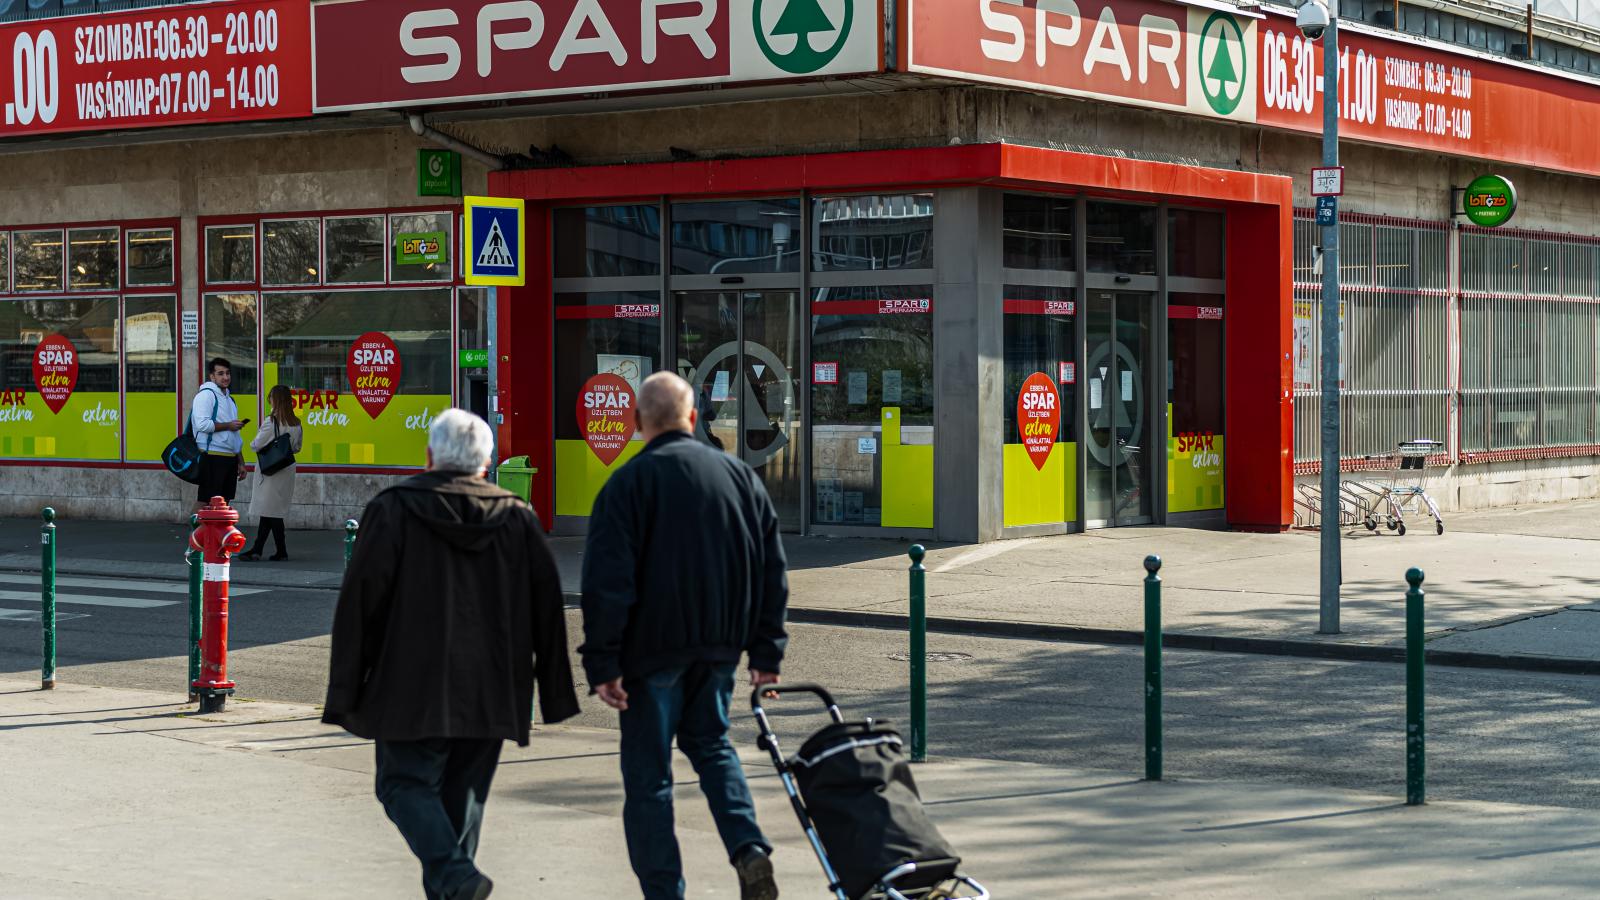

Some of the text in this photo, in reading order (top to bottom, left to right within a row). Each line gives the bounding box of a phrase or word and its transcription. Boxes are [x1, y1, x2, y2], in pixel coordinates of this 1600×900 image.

[400, 0, 718, 84] SPAR
[980, 0, 1181, 90] SPAR
[621, 304, 650, 312] SPAR
[886, 300, 919, 308] SPAR
[38, 350, 72, 364] SPAR
[354, 350, 394, 364] SPAR
[40, 370, 70, 387] extra
[356, 370, 392, 388] extra
[584, 392, 630, 408] SPAR
[1023, 392, 1055, 410] SPAR
[82, 401, 120, 423] extra
[308, 404, 350, 427] extra
[588, 416, 627, 432] extra
[1025, 417, 1052, 436] extra
[1178, 432, 1214, 452] SPAR
[1192, 445, 1220, 468] extra
